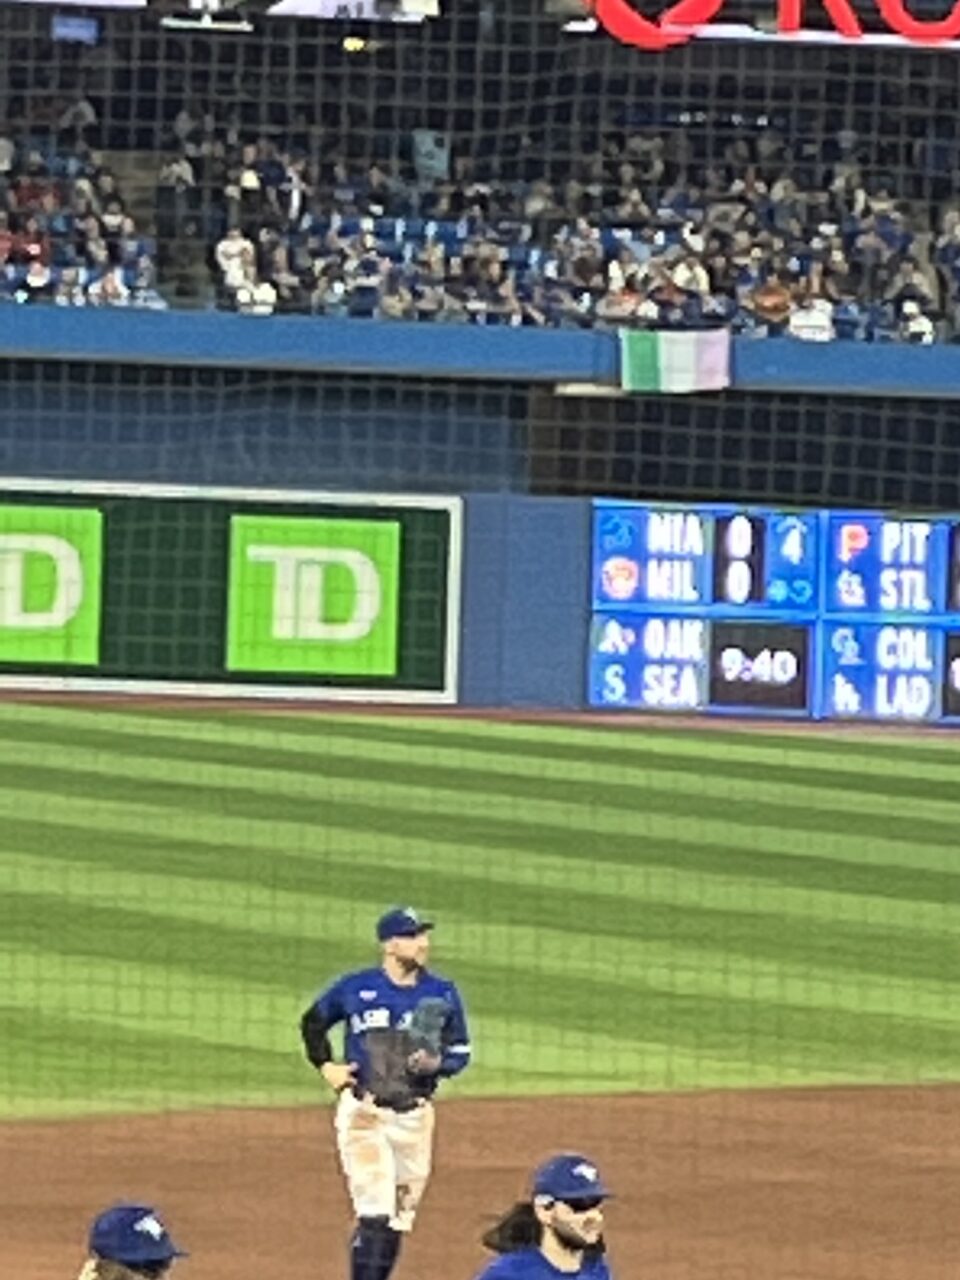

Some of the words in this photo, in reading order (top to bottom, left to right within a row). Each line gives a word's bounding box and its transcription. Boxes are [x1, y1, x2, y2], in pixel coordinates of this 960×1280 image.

[647, 512, 704, 556] MIA
[726, 515, 752, 558] 0
[781, 527, 804, 566] 4
[881, 521, 932, 565] PIT
[0, 532, 84, 629] D
[246, 543, 382, 642] TD
[647, 559, 700, 601] MIL
[726, 560, 751, 604] 0
[880, 568, 932, 612] STL
[643, 618, 704, 660] OAK
[721, 647, 798, 683] 9:40
[876, 625, 933, 671] COL
[641, 664, 699, 707] SEA
[875, 674, 932, 718] LAD
